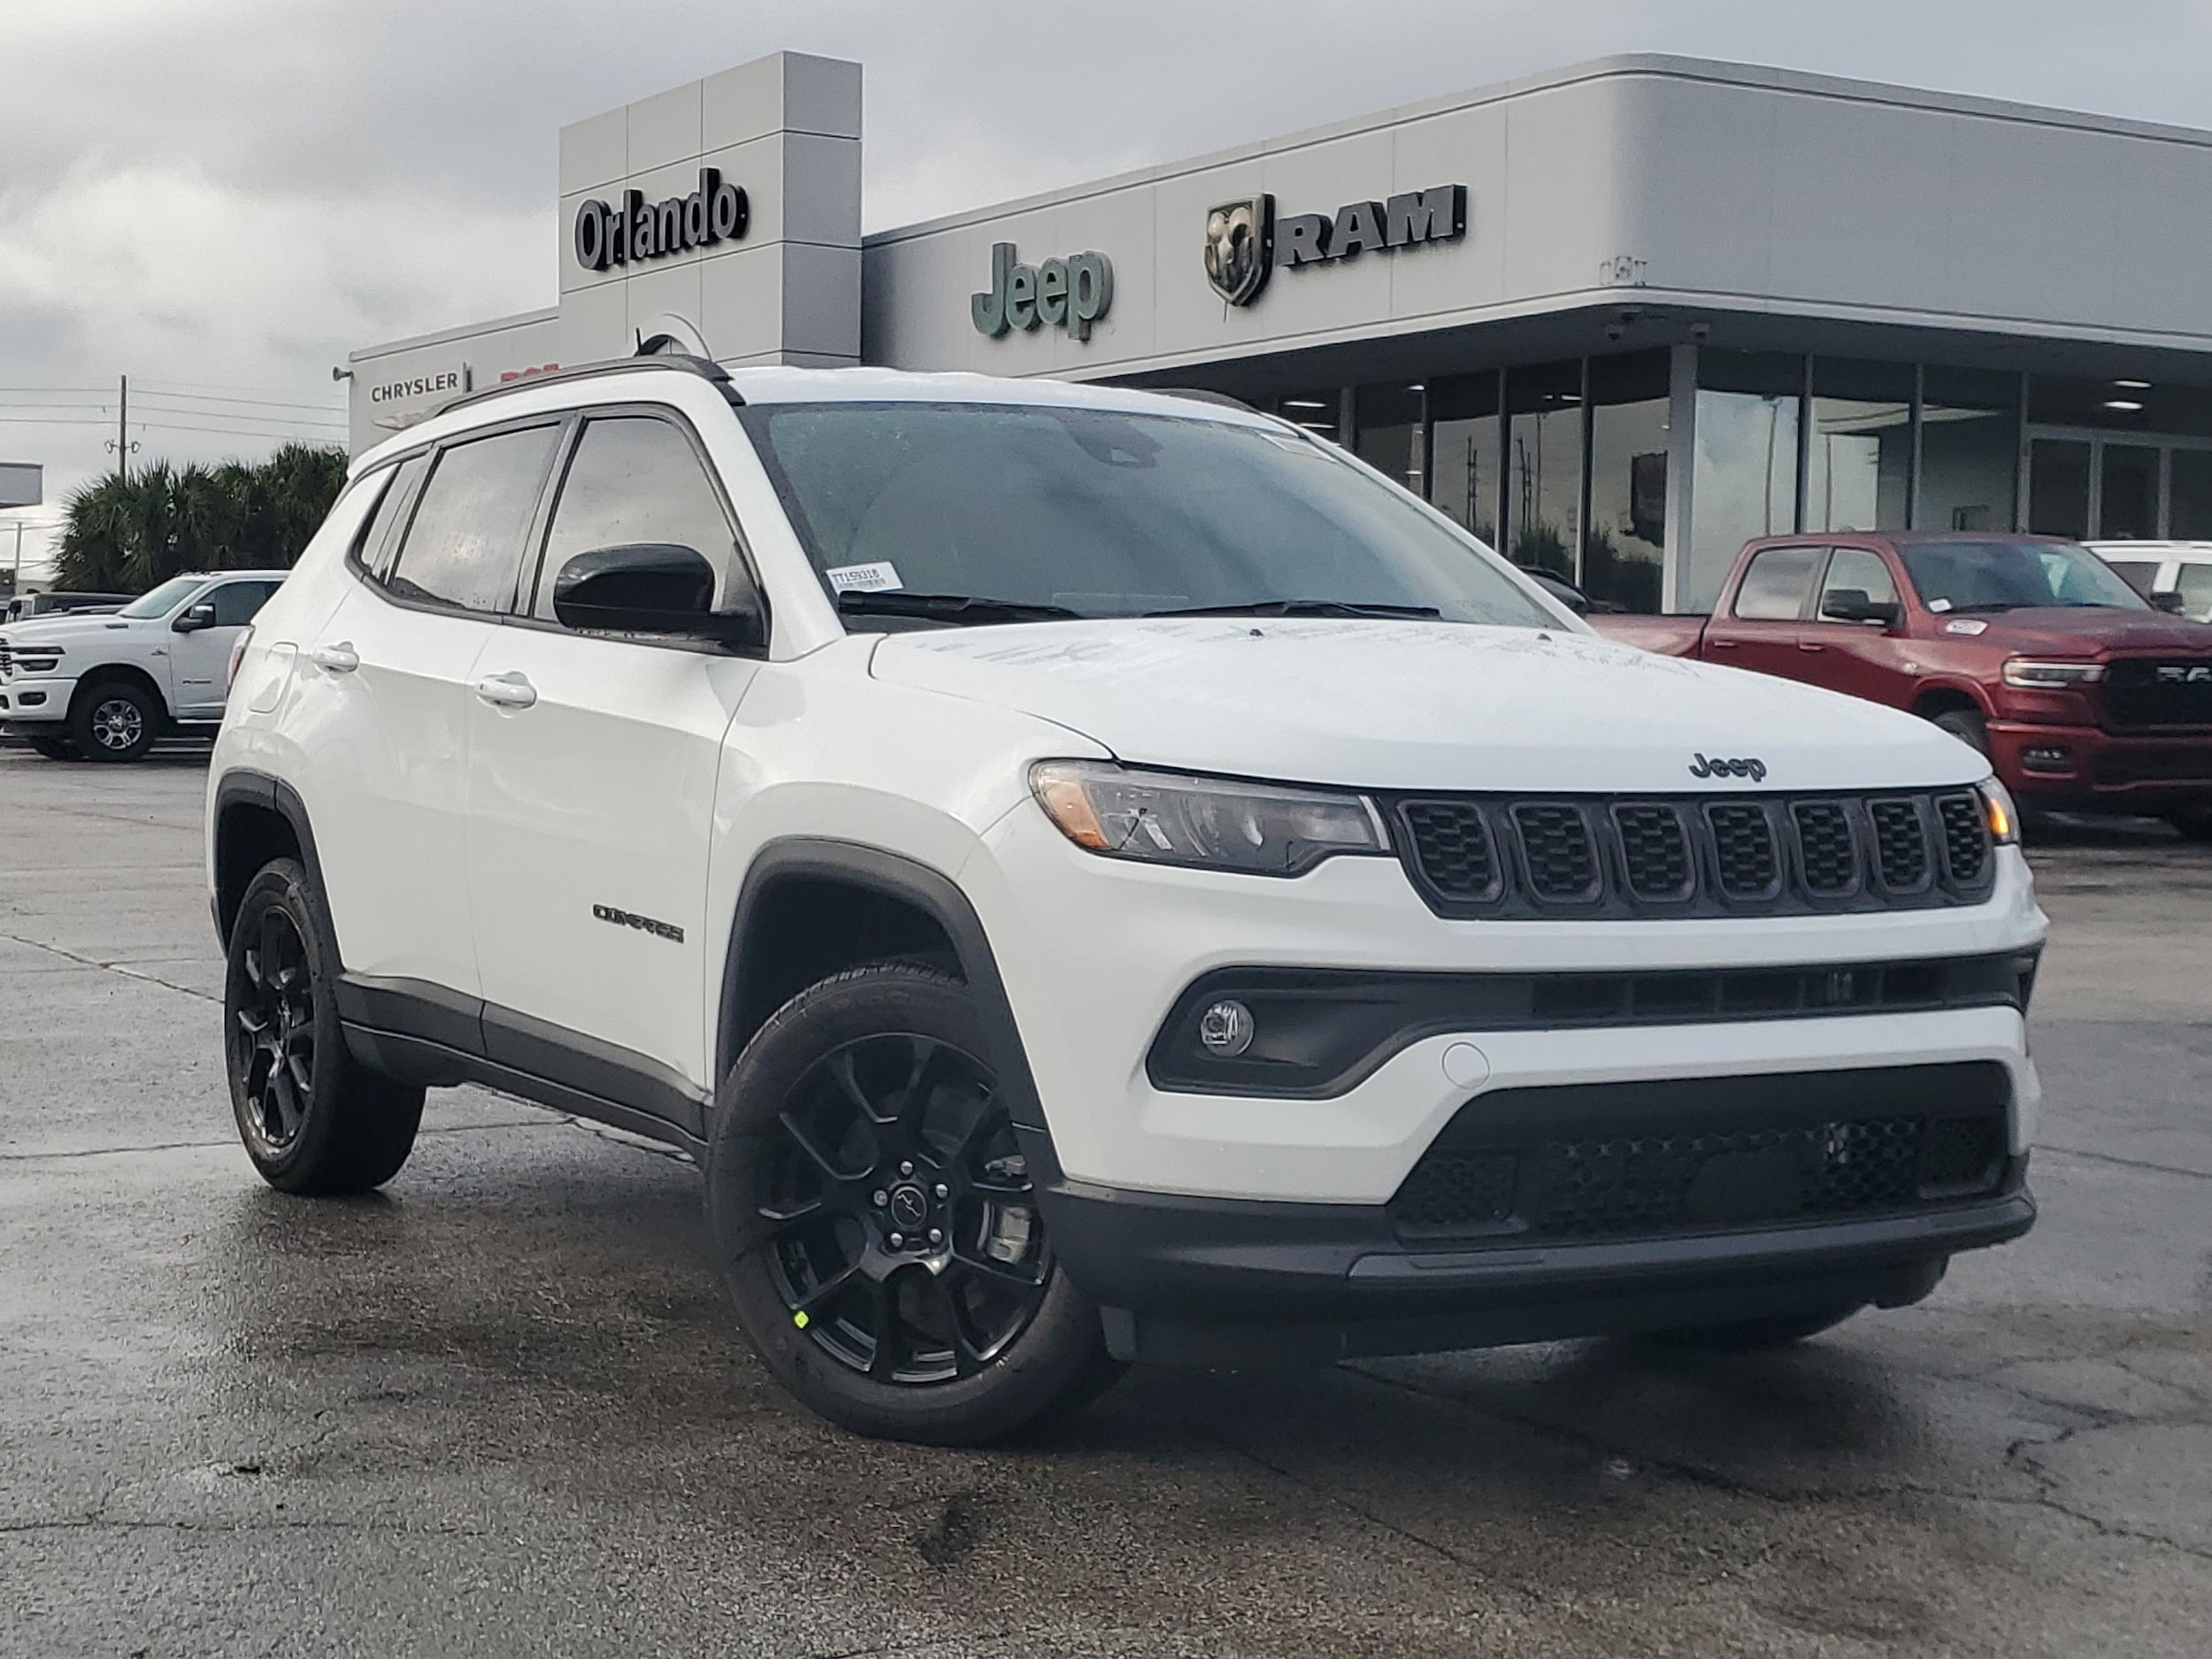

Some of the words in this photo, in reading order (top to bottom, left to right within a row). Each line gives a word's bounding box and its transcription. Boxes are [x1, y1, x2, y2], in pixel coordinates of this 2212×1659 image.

[575, 167, 749, 271] Orlando
[1275, 184, 1467, 269] RAM
[972, 242, 1114, 342] Jeep
[371, 373, 458, 402] CHRYSLER
[1688, 753, 1767, 783] Jeep
